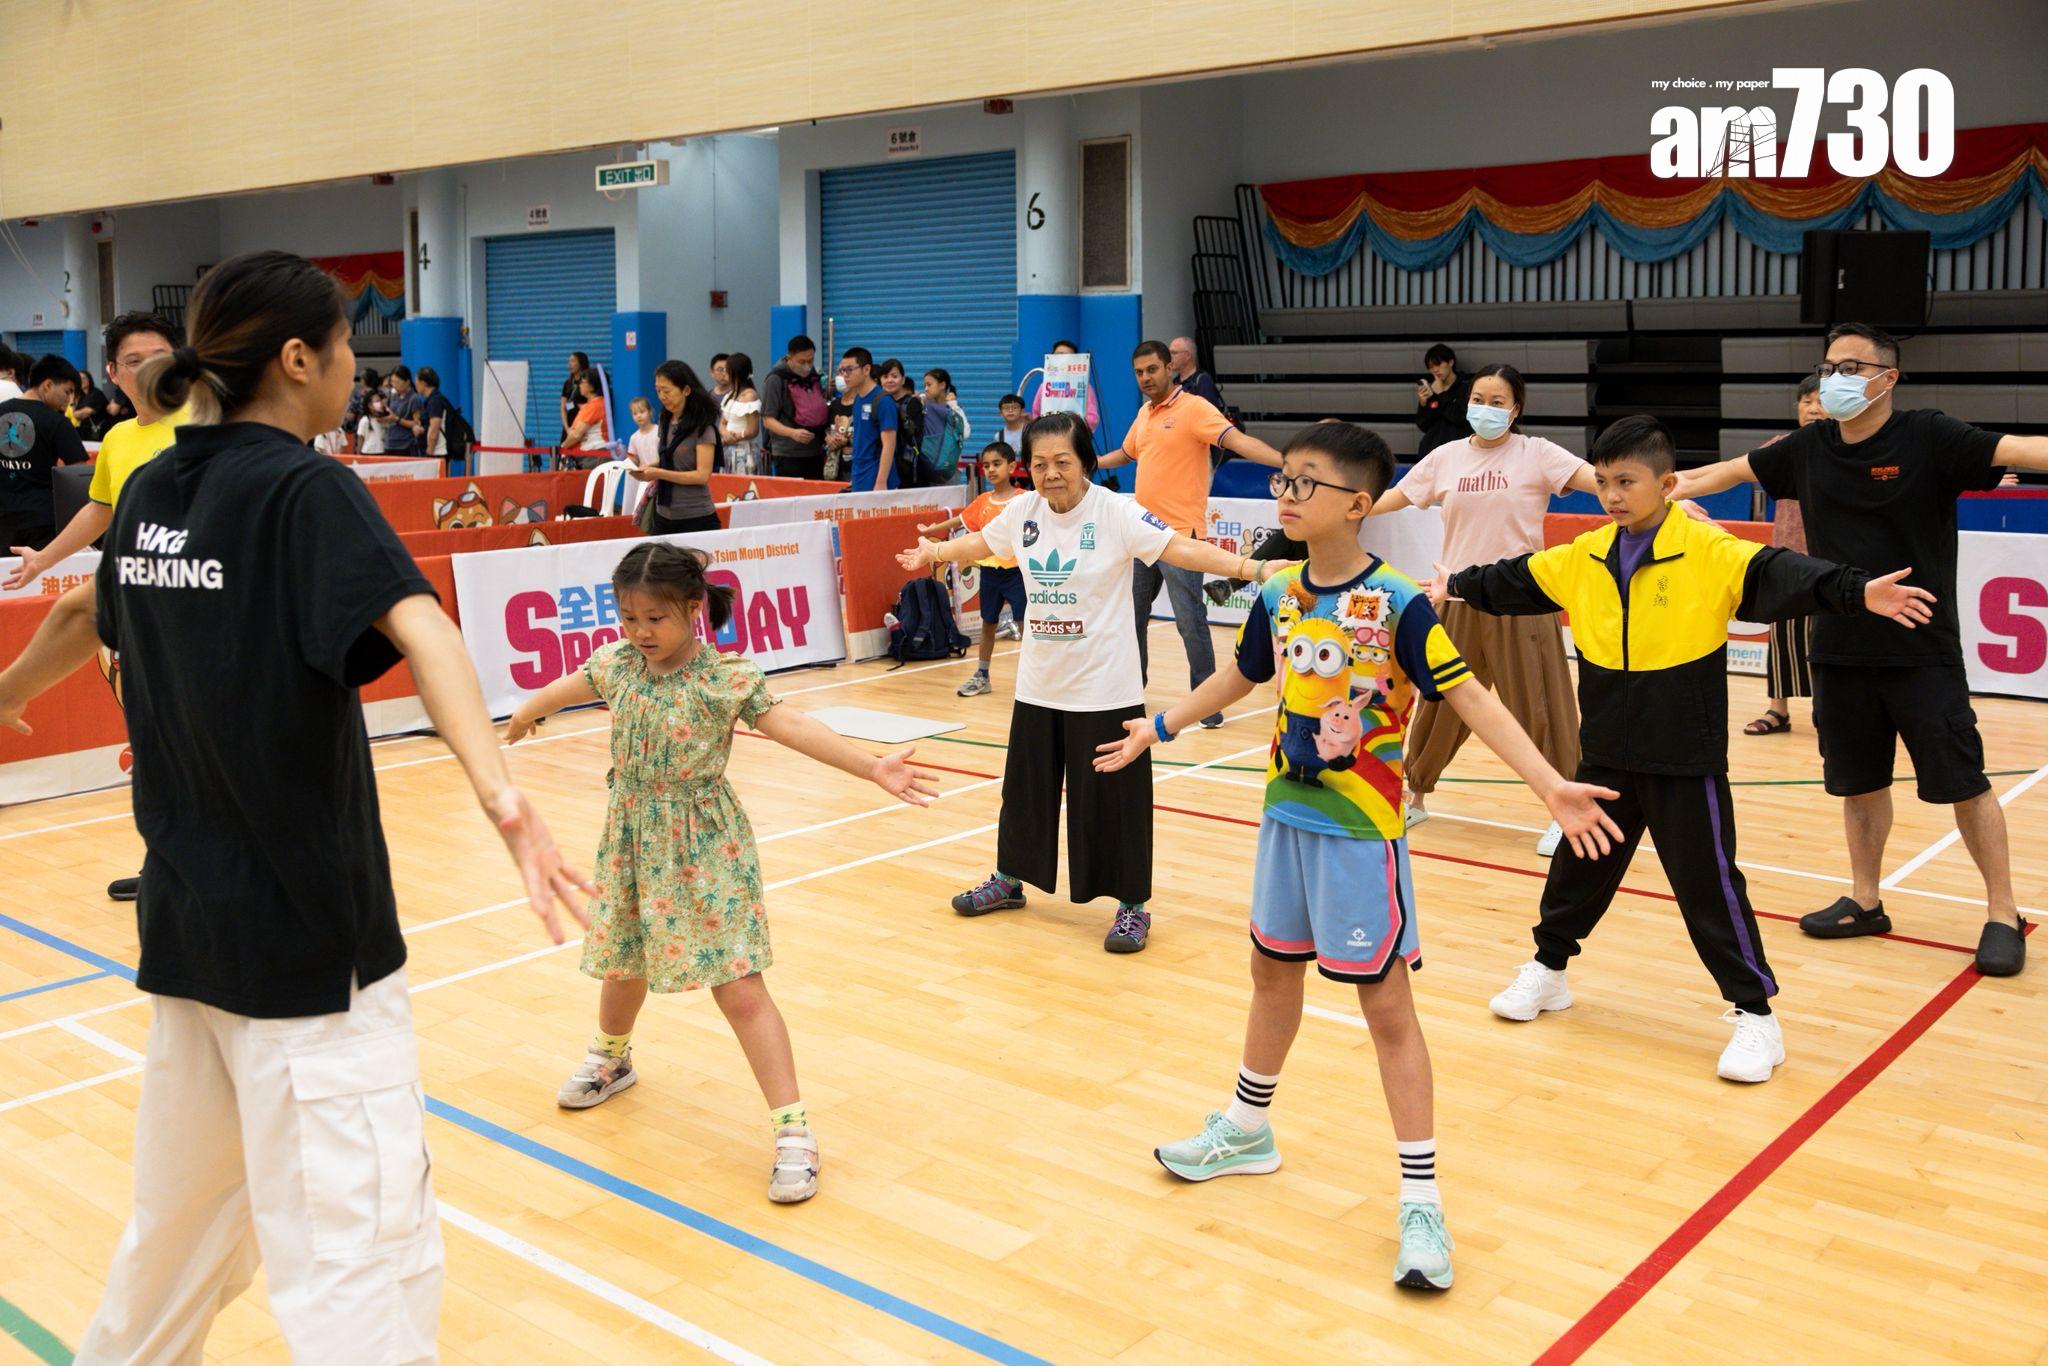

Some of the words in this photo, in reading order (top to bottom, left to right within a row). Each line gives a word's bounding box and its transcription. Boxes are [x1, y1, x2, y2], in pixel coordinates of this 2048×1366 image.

[605, 169, 632, 185] EXIT
[1027, 192, 1046, 230] 6
[418, 242, 431, 270] 4
[64, 269, 71, 293] 2
[1458, 470, 1509, 492] mathis
[136, 521, 189, 554] HKG
[714, 548, 738, 563] Tsim
[738, 546, 765, 561] Mong
[766, 542, 799, 558] District
[115, 556, 224, 590] REAKING
[1029, 590, 1077, 605] adidas
[1030, 621, 1064, 634] adidas
